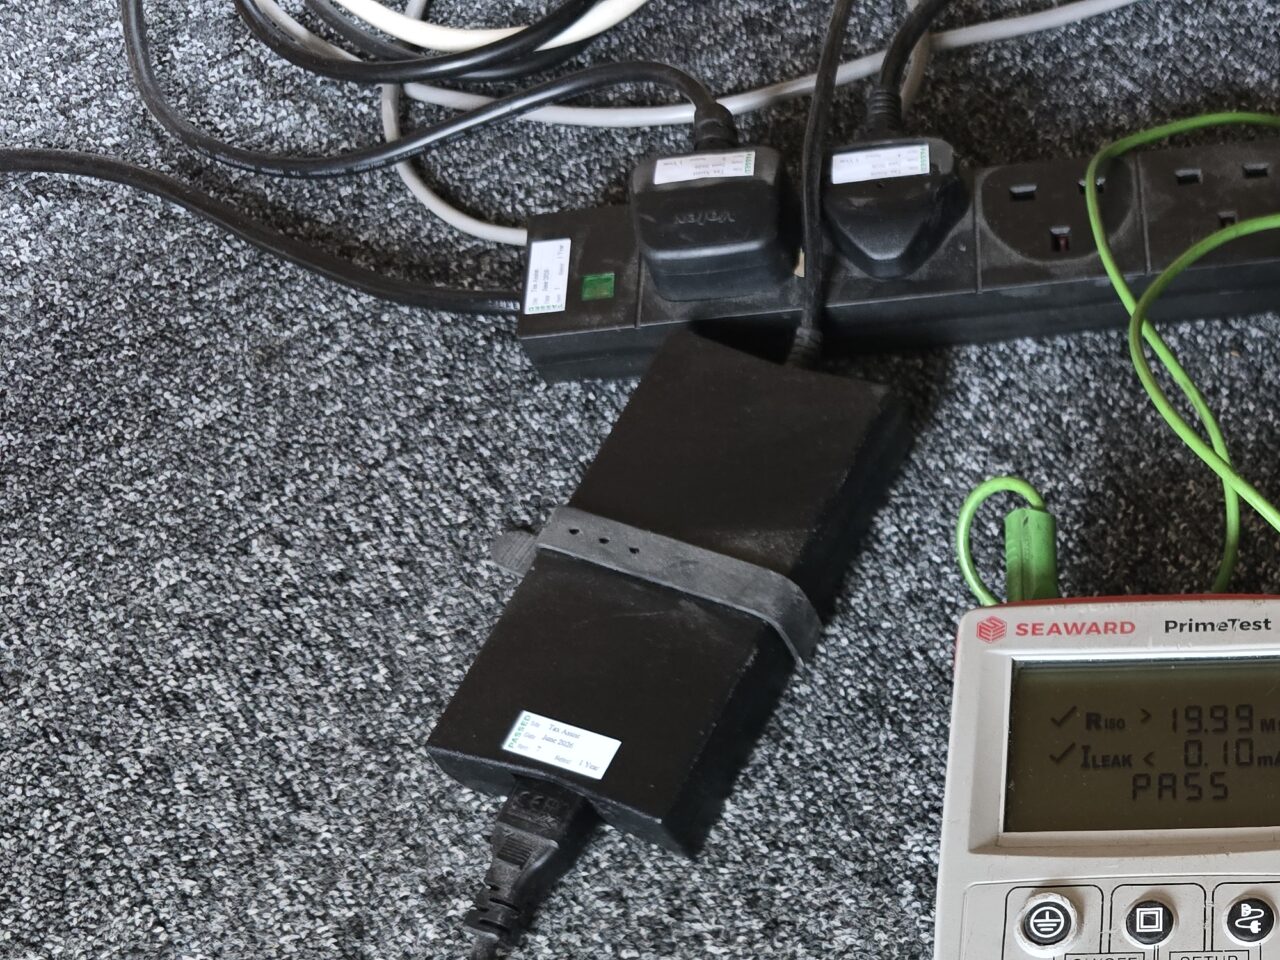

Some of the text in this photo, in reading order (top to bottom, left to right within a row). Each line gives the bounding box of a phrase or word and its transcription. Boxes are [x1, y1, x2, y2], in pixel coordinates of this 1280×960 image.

[1015, 620, 1136, 637] SEAWARD
[1164, 617, 1272, 634] PrimeTest
[508, 715, 531, 748] PASSED
[1172, 704, 1254, 735] 19.99
[1132, 772, 1229, 801] PASS
